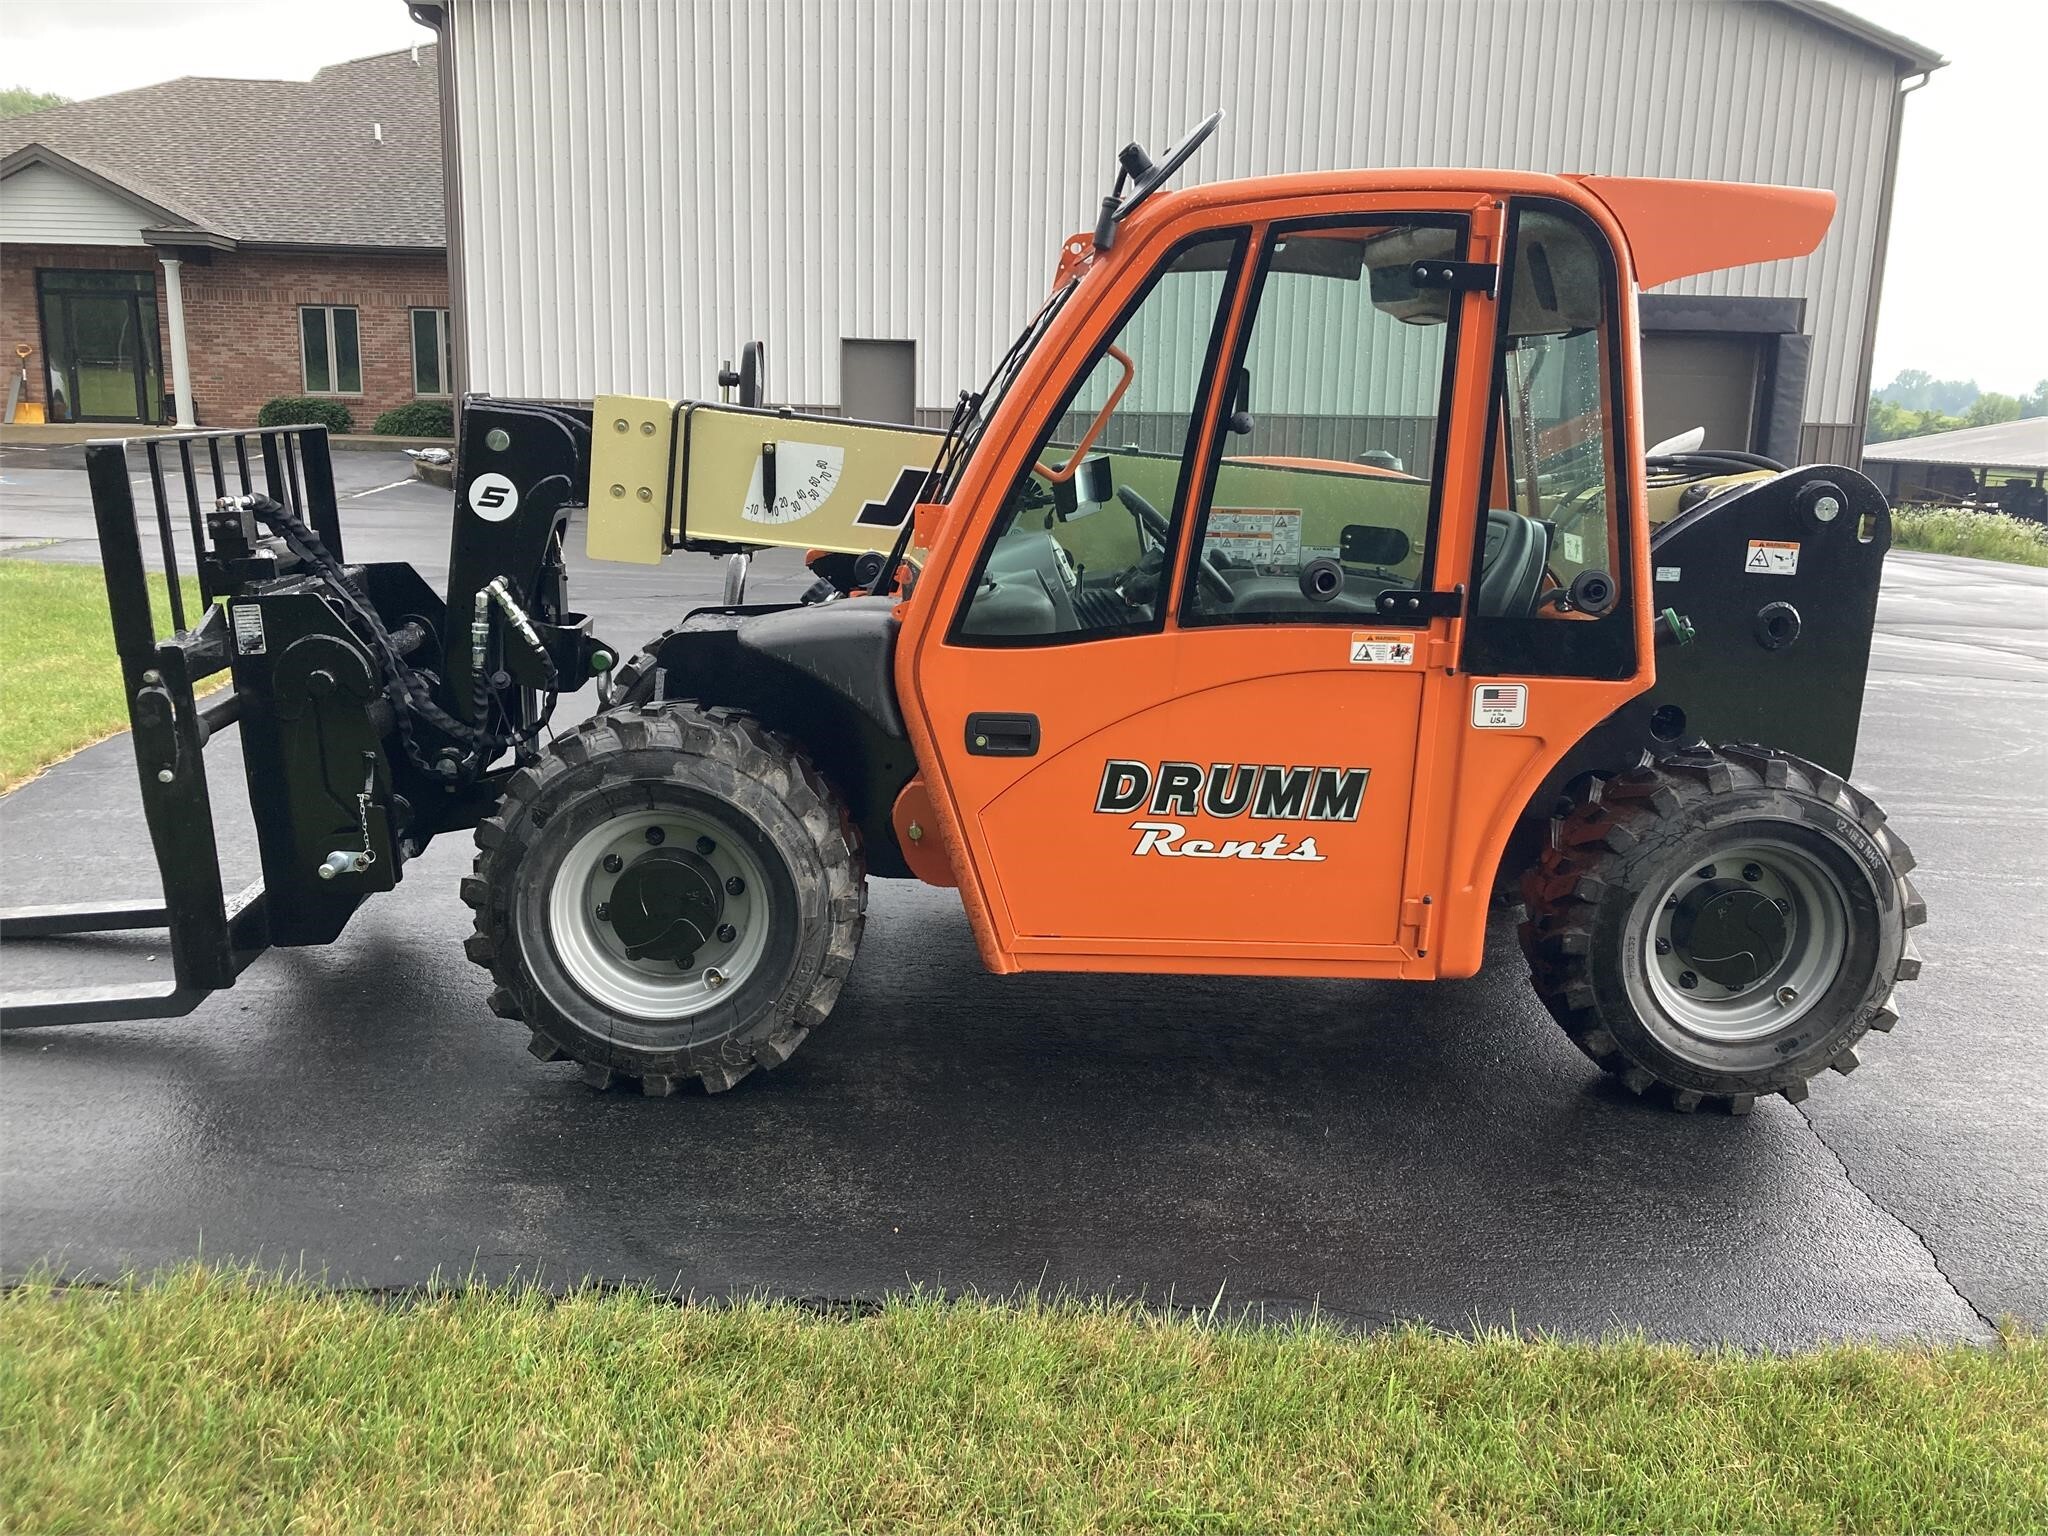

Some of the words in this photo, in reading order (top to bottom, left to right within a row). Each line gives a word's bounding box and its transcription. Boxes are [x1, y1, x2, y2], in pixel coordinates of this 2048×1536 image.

[816, 459, 828, 470] 80
[808, 476, 821, 488] 60
[819, 471, 832, 482] 70
[796, 489, 807, 501] 40
[807, 488, 820, 501] 50
[779, 496, 789, 509] 20
[790, 500, 801, 513] 30
[745, 503, 759, 516] -10
[1490, 716, 1506, 724] USA
[1094, 758, 1371, 822] DRUMM
[1129, 821, 1328, 862] Rents
